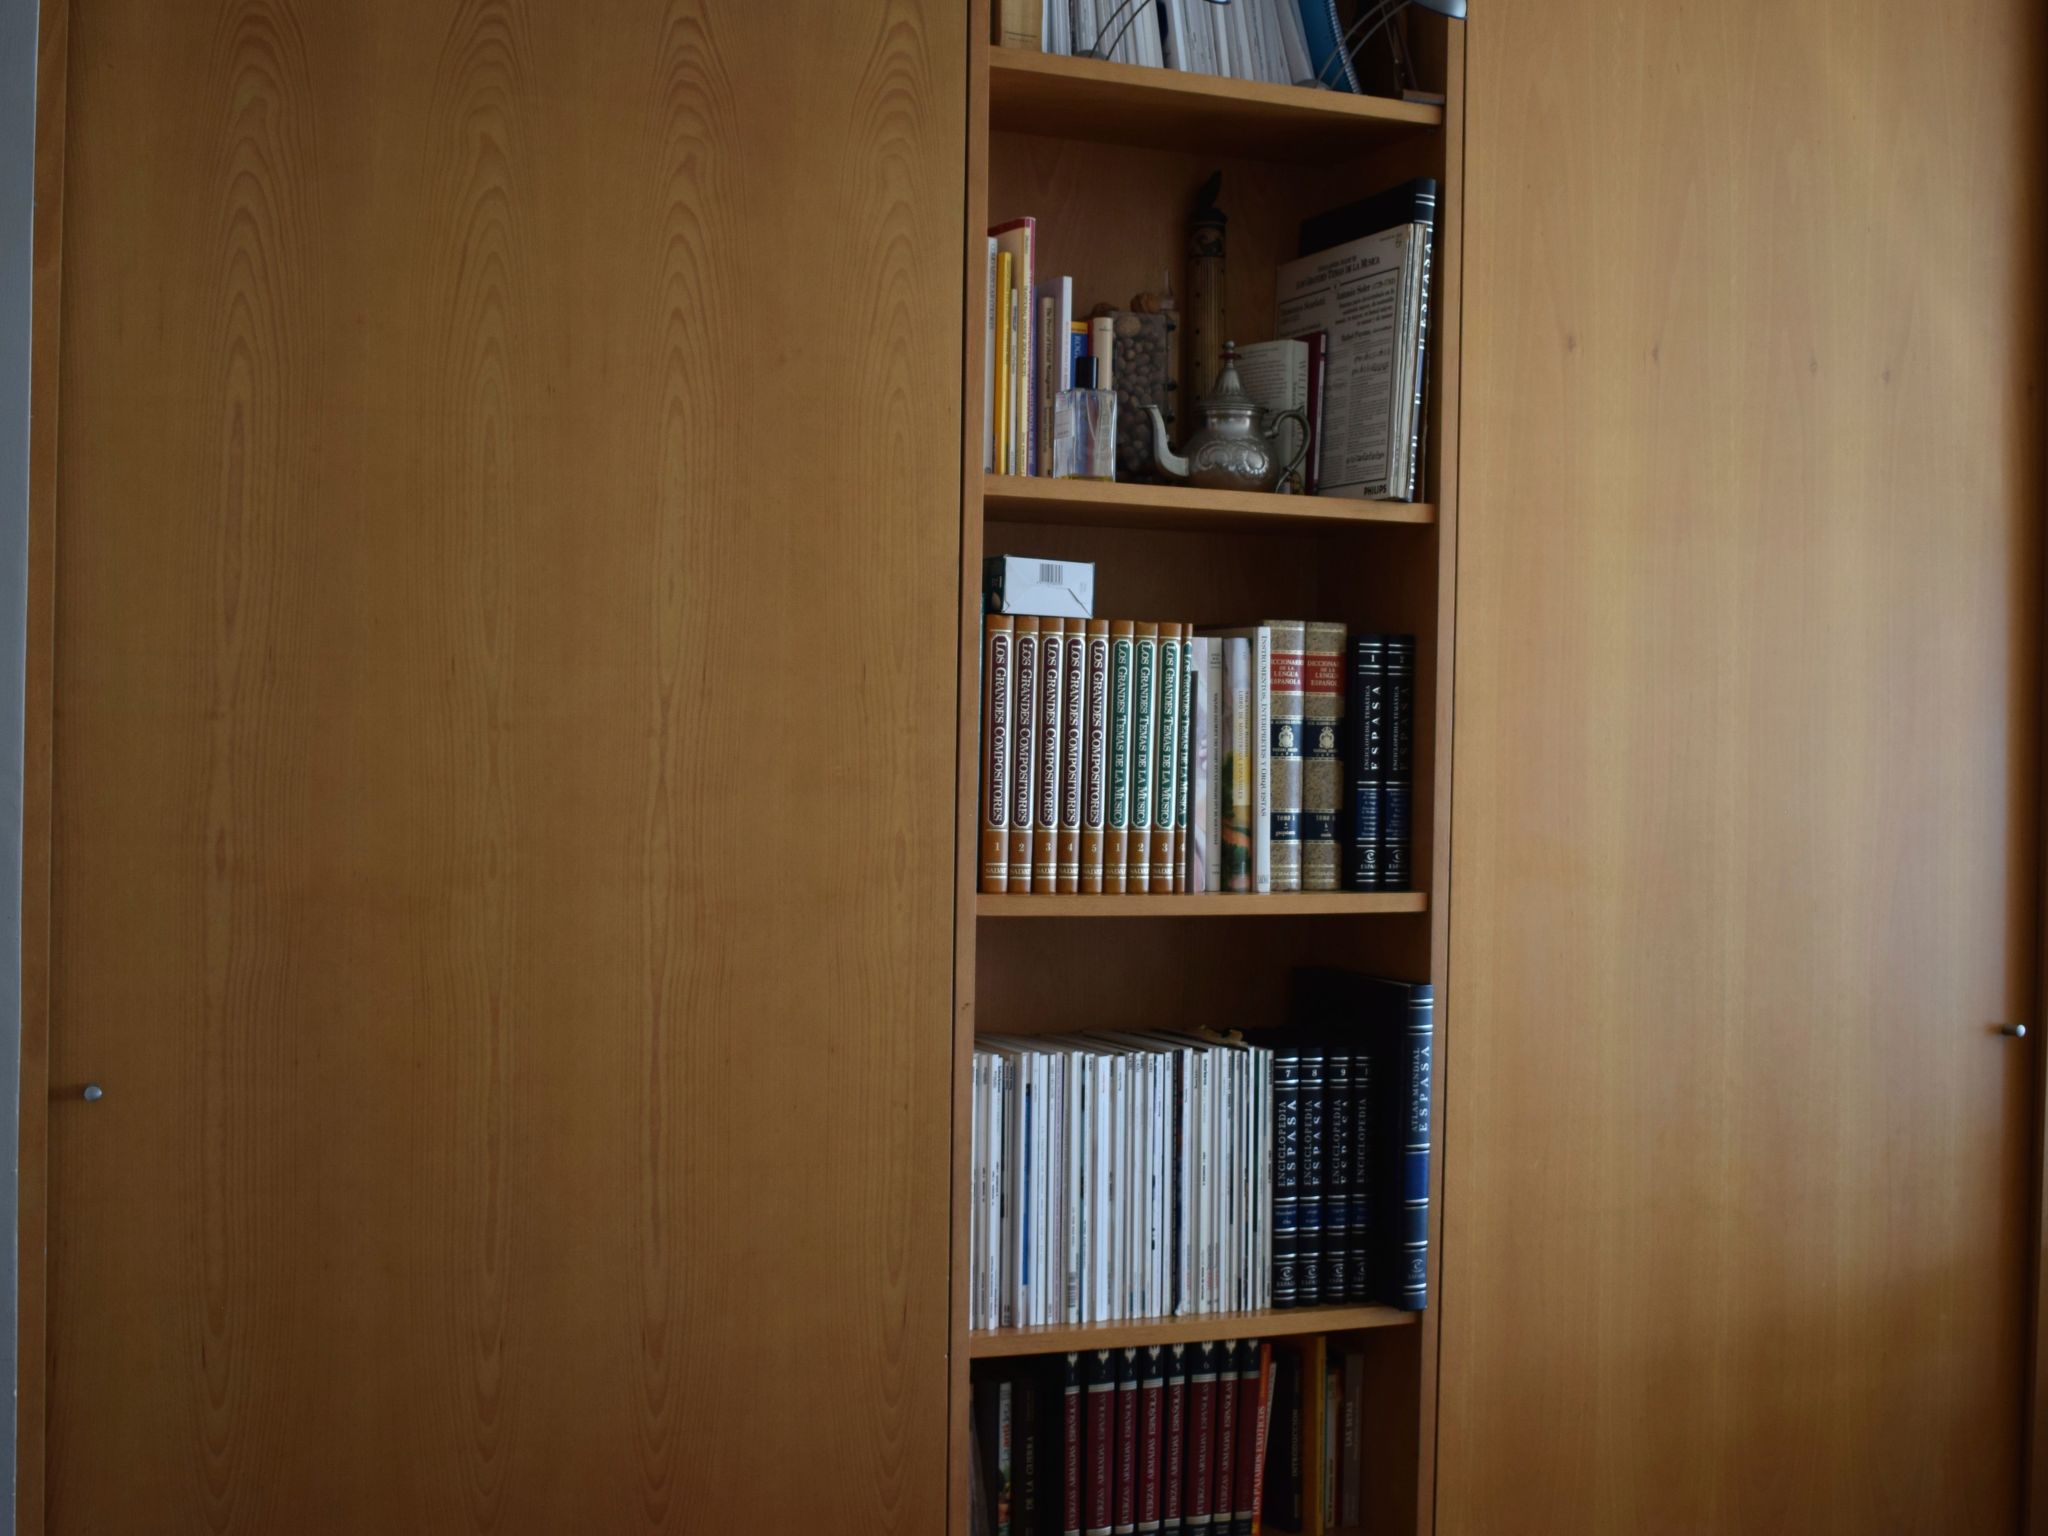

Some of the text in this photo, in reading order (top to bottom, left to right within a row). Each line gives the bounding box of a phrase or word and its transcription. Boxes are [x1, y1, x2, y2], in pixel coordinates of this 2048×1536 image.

[1363, 484, 1387, 496] PHILIPS
[1117, 644, 1128, 664] LOS
[1140, 644, 1151, 664] LOS
[1165, 645, 1176, 665] LOS
[1117, 666, 1128, 713] GRANDES
[1139, 666, 1150, 714] GRANDES
[1164, 667, 1175, 714] GRANDES
[993, 641, 1007, 821] LOS GRANDES COMPOSITORES
[1018, 643, 1033, 822] LOS GRANDES COMPOSITORES
[1044, 643, 1058, 821] LOS GRANDES COMPOSITORES
[1067, 644, 1081, 822] LOS GRANDES COMPOSITORES
[1090, 646, 1104, 823] LOS GRANDES COMPOSITORES
[1115, 715, 1127, 751] TEMAS
[1138, 715, 1149, 751] TEMAS
[1163, 716, 1174, 752] TEMAS
[1371, 686, 1381, 770] ESPASA
[1114, 754, 1123, 767] DE
[1114, 769, 1123, 783] LA
[1137, 769, 1146, 783] LA
[1138, 754, 1146, 767] DE
[1162, 755, 1171, 768] DE
[1162, 770, 1171, 784] LA
[994, 842, 1000, 851] 1
[1018, 842, 1025, 852] 2
[1045, 842, 1052, 852] 3
[1067, 842, 1073, 851] 4
[1091, 843, 1097, 853] 5
[1115, 842, 1120, 852] 1
[1137, 842, 1144, 852] 2
[1161, 842, 1168, 852] 3
[1285, 1069, 1291, 1078] 7
[1311, 1068, 1318, 1077] 8
[1340, 1067, 1346, 1077] 9
[1411, 1047, 1420, 1132] ATLAS MUNDIAL
[1419, 1046, 1430, 1132] ESPASA
[1278, 1100, 1287, 1187] ENCICLOPEDIA
[1287, 1099, 1297, 1186] ESPASA
[1303, 1099, 1312, 1186] ENCICLOPEDIA
[1312, 1100, 1321, 1185] ESPASA
[1331, 1099, 1341, 1185] ENCICLOPEDIA
[1356, 1098, 1366, 1184] ENCICLOPEDIA
[1026, 1435, 1035, 1475] GUERRA
[1145, 1389, 1157, 1520] FUERZAS ARMADAS ESPAÑOLAS
[1169, 1385, 1181, 1517] FUERZAS ARMADAS ESPAÑOLAS
[1196, 1383, 1208, 1514] FUERZAS ARMADAS ESPAÑOLAS
[1220, 1381, 1232, 1512] FUERZAS ARMADAS ESPAÑOLAS
[1344, 1429, 1353, 1447] LAS
[1068, 1394, 1078, 1528] FUERZAS ARMADAS ESPAÑOLAS
[1096, 1393, 1107, 1526] FUERZAS ARMADAS ESPAÑOLAS
[1122, 1391, 1132, 1523] FUERZAS ARMADAS ESPAÑOLAS
[1026, 1480, 1034, 1492] LA
[1251, 1496, 1260, 1516] LOS
